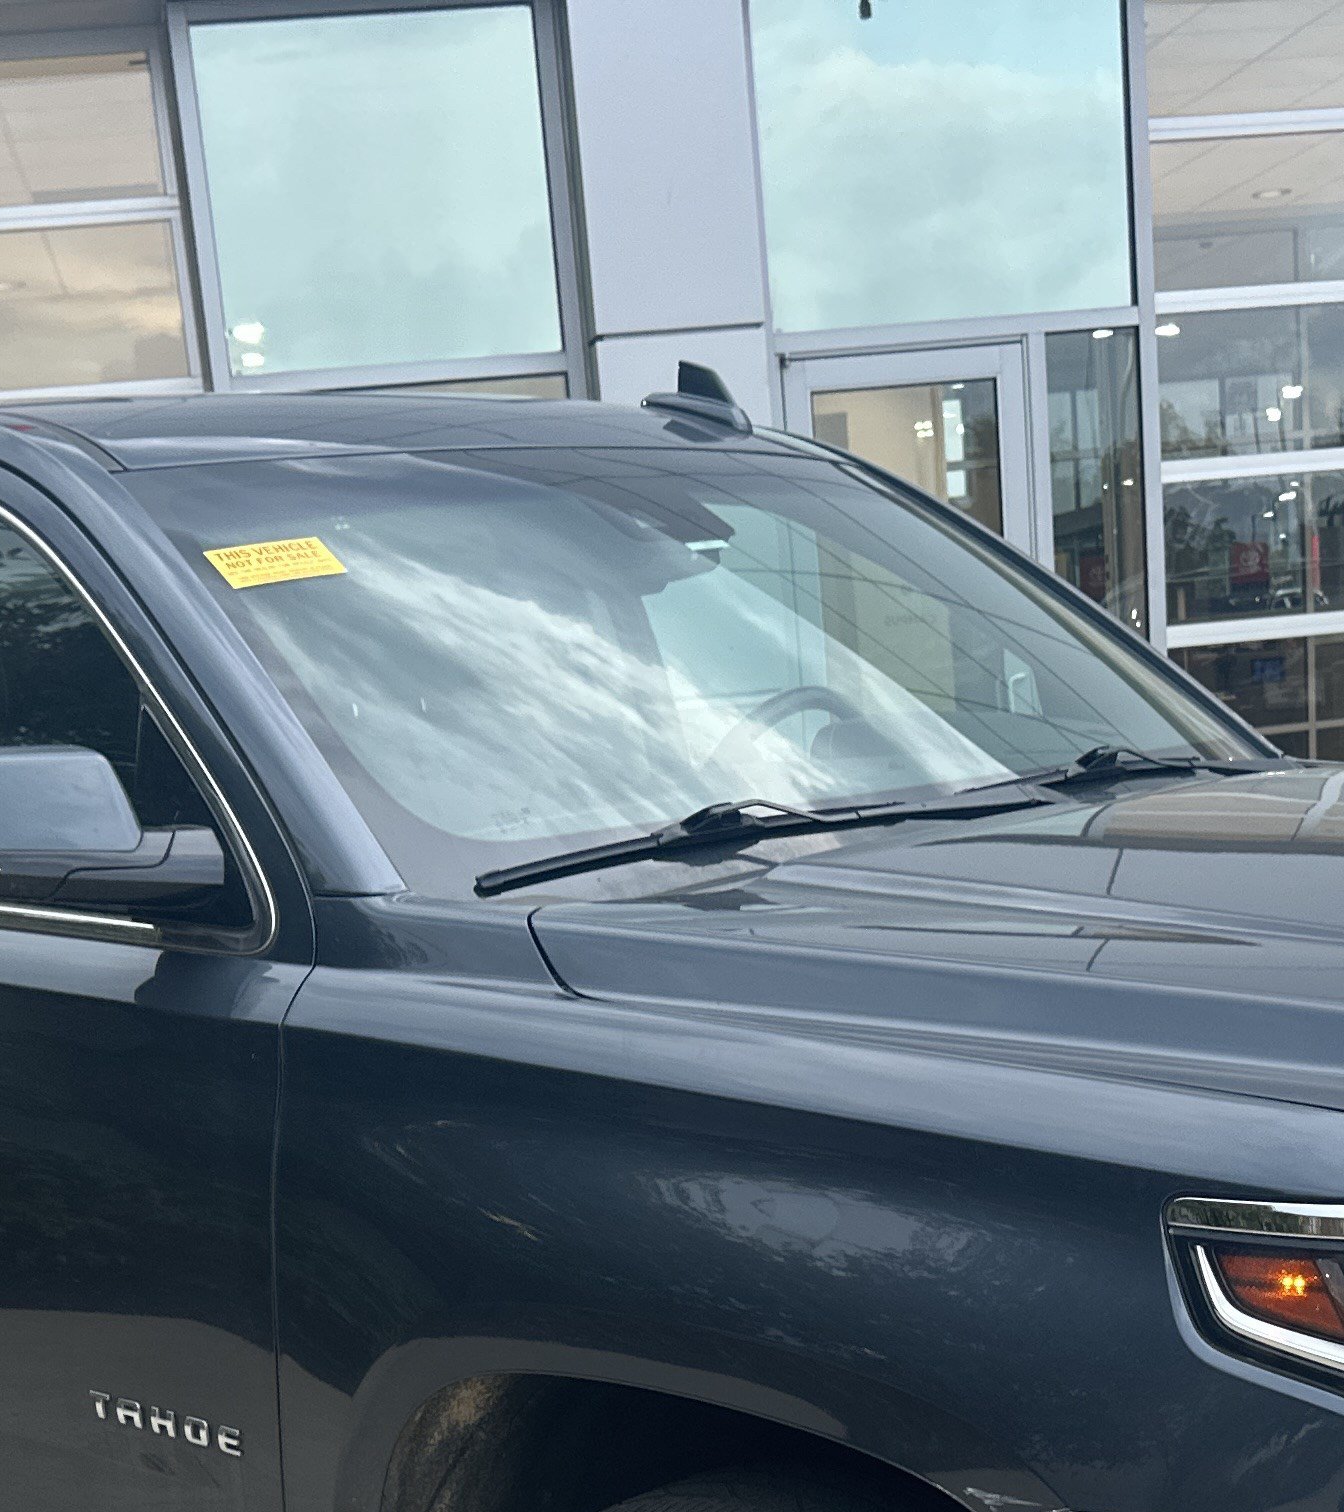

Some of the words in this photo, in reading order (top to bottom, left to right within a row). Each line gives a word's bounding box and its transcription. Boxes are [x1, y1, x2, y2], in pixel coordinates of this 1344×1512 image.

[215, 549, 251, 562] THIS
[251, 540, 318, 555] VEHICLE
[225, 559, 252, 570] NOT
[256, 555, 284, 565] FOR
[287, 550, 321, 560] SALE
[89, 1390, 242, 1457] TAHOE
